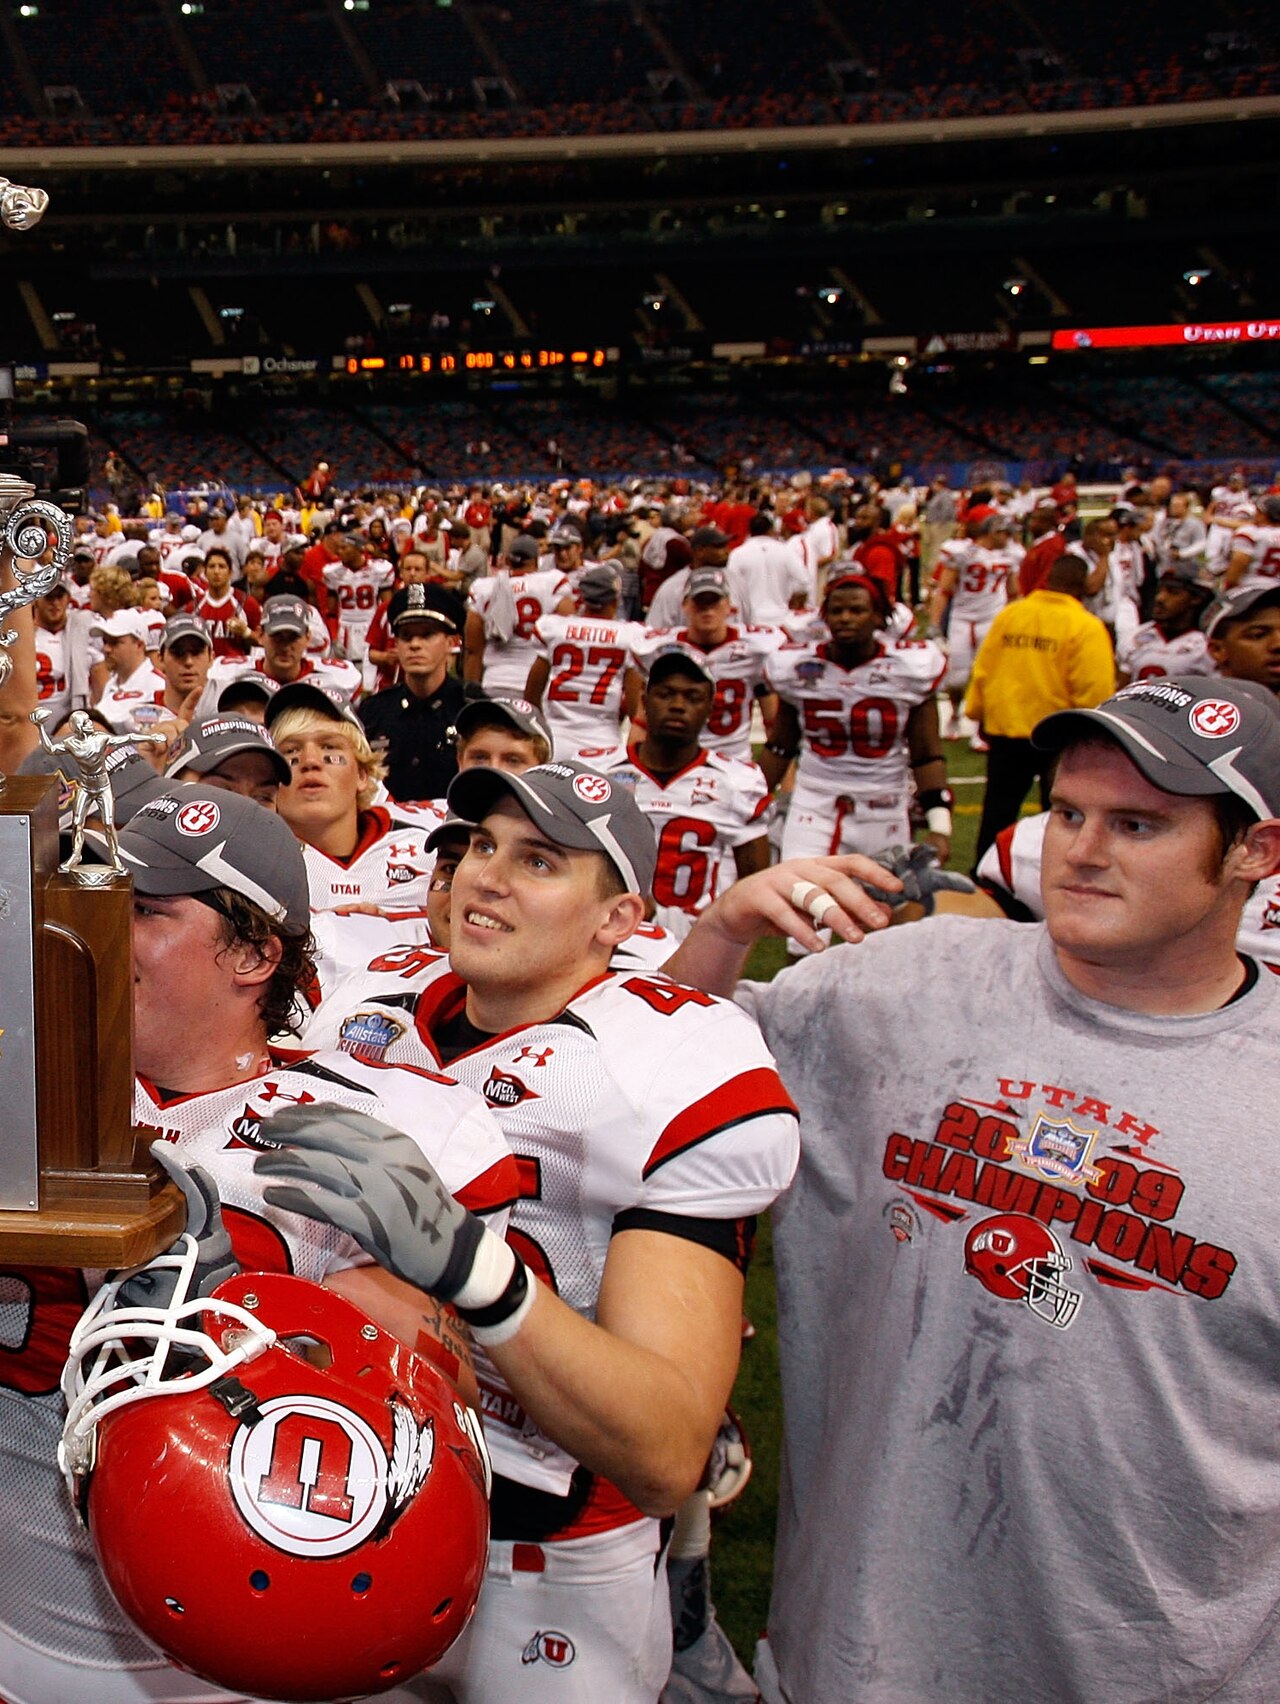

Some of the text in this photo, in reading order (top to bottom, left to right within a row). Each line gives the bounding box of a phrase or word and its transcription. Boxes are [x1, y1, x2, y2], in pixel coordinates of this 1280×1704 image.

[263, 356, 317, 371] Ochsner
[964, 563, 1009, 593] 37
[338, 584, 374, 610] 28
[565, 624, 618, 644] BURTON
[547, 643, 626, 706] 27
[202, 719, 258, 738] CHAMPIONS
[803, 696, 898, 758] 50
[652, 816, 717, 910] 6
[330, 883, 361, 896] UTAH
[346, 1025, 388, 1045] Allstate
[996, 1078, 1161, 1146] UTAH
[881, 1131, 1239, 1301] CHAMPIONS
[478, 1387, 520, 1422] TAH
[257, 1411, 355, 1524] U
[543, 1637, 569, 1663] U
